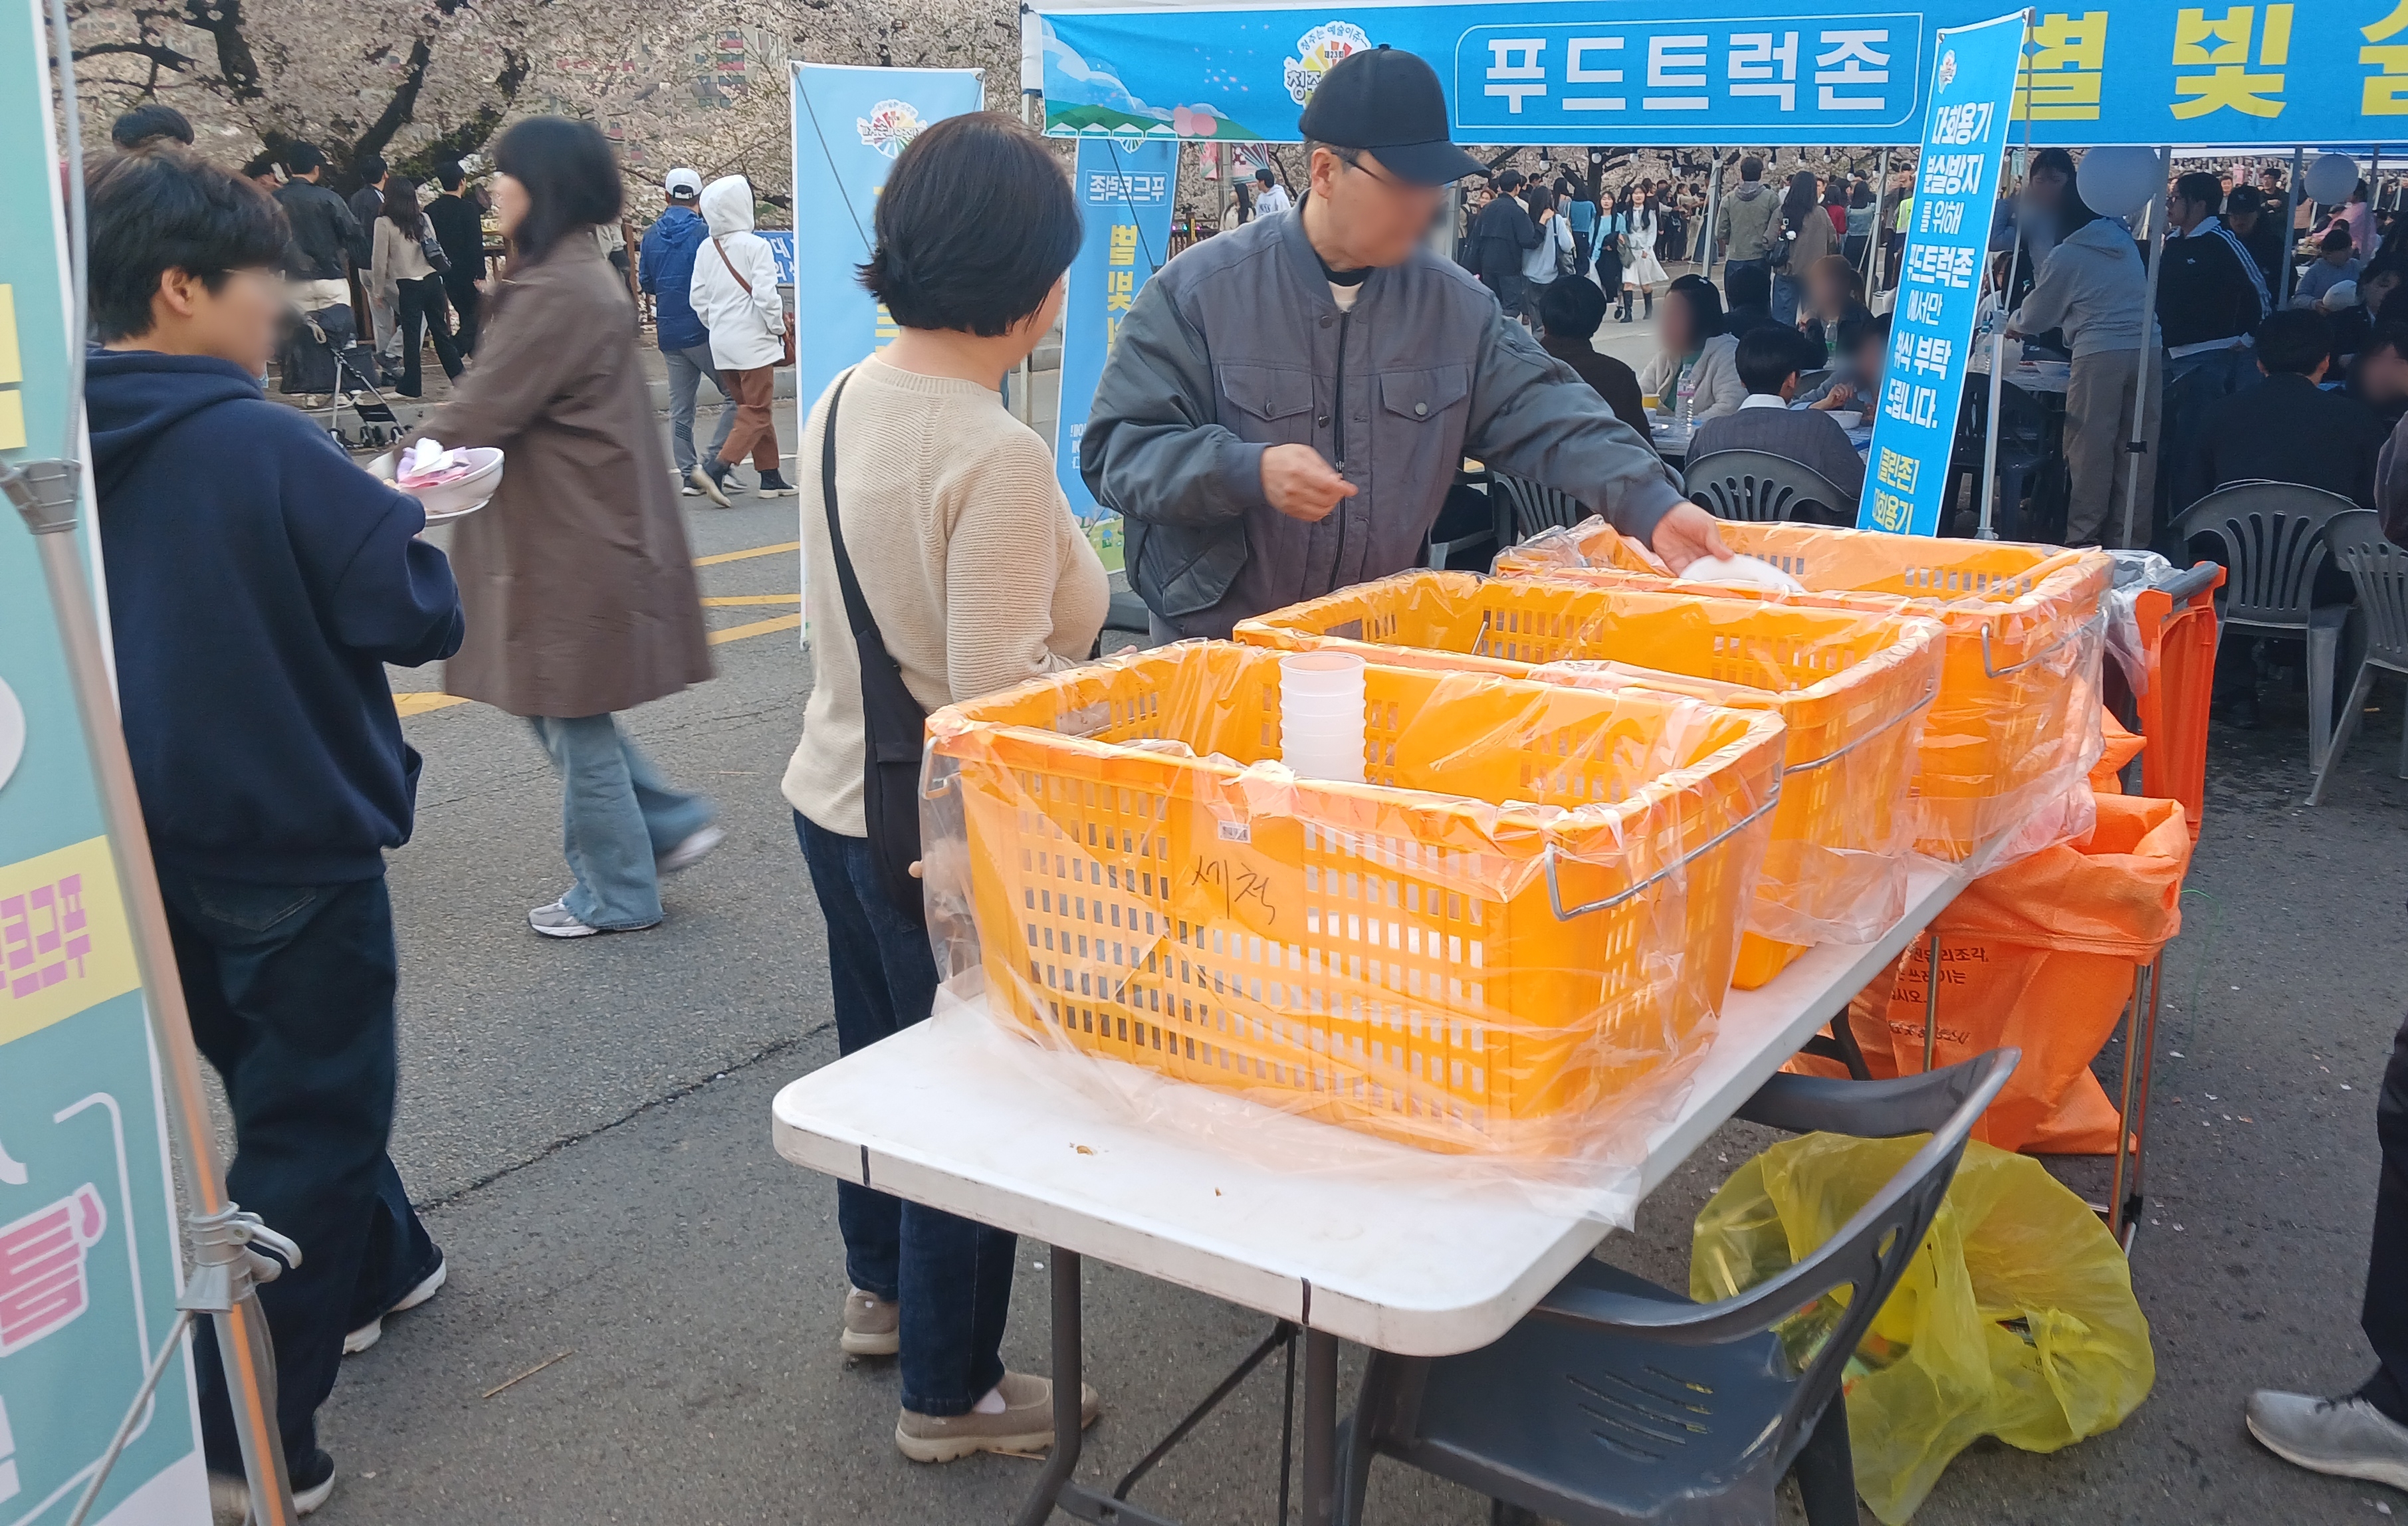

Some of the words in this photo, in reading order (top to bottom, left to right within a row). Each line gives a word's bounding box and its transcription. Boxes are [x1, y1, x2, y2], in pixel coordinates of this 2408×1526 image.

[1301, 30, 1325, 50] 청주는
[1484, 29, 1891, 114] 푸드트럭존
[1931, 101, 1995, 145] 다회용기
[1923, 154, 1985, 194] 분실방지
[1919, 201, 1933, 233] 를
[1933, 200, 1965, 235] 위해
[1907, 288, 1943, 326] 에서만
[1914, 335, 1952, 381] 부탁
[1886, 378, 1937, 429] 드립니다.
